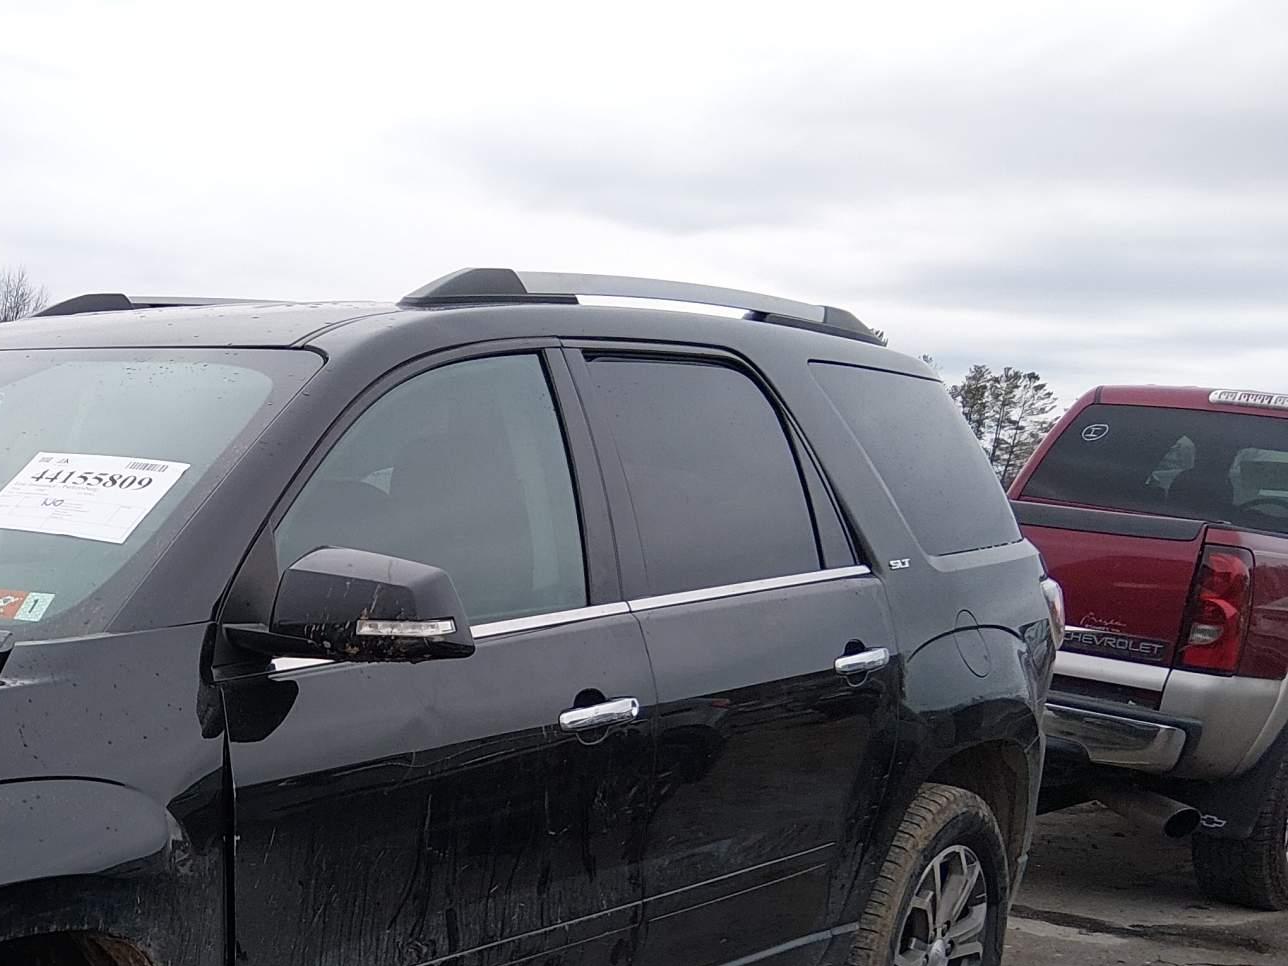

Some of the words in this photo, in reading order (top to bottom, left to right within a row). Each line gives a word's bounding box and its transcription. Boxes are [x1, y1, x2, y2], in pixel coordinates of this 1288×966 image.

[31, 468, 153, 491] 44155809
[889, 558, 911, 570] SLT
[29, 599, 39, 614] 1
